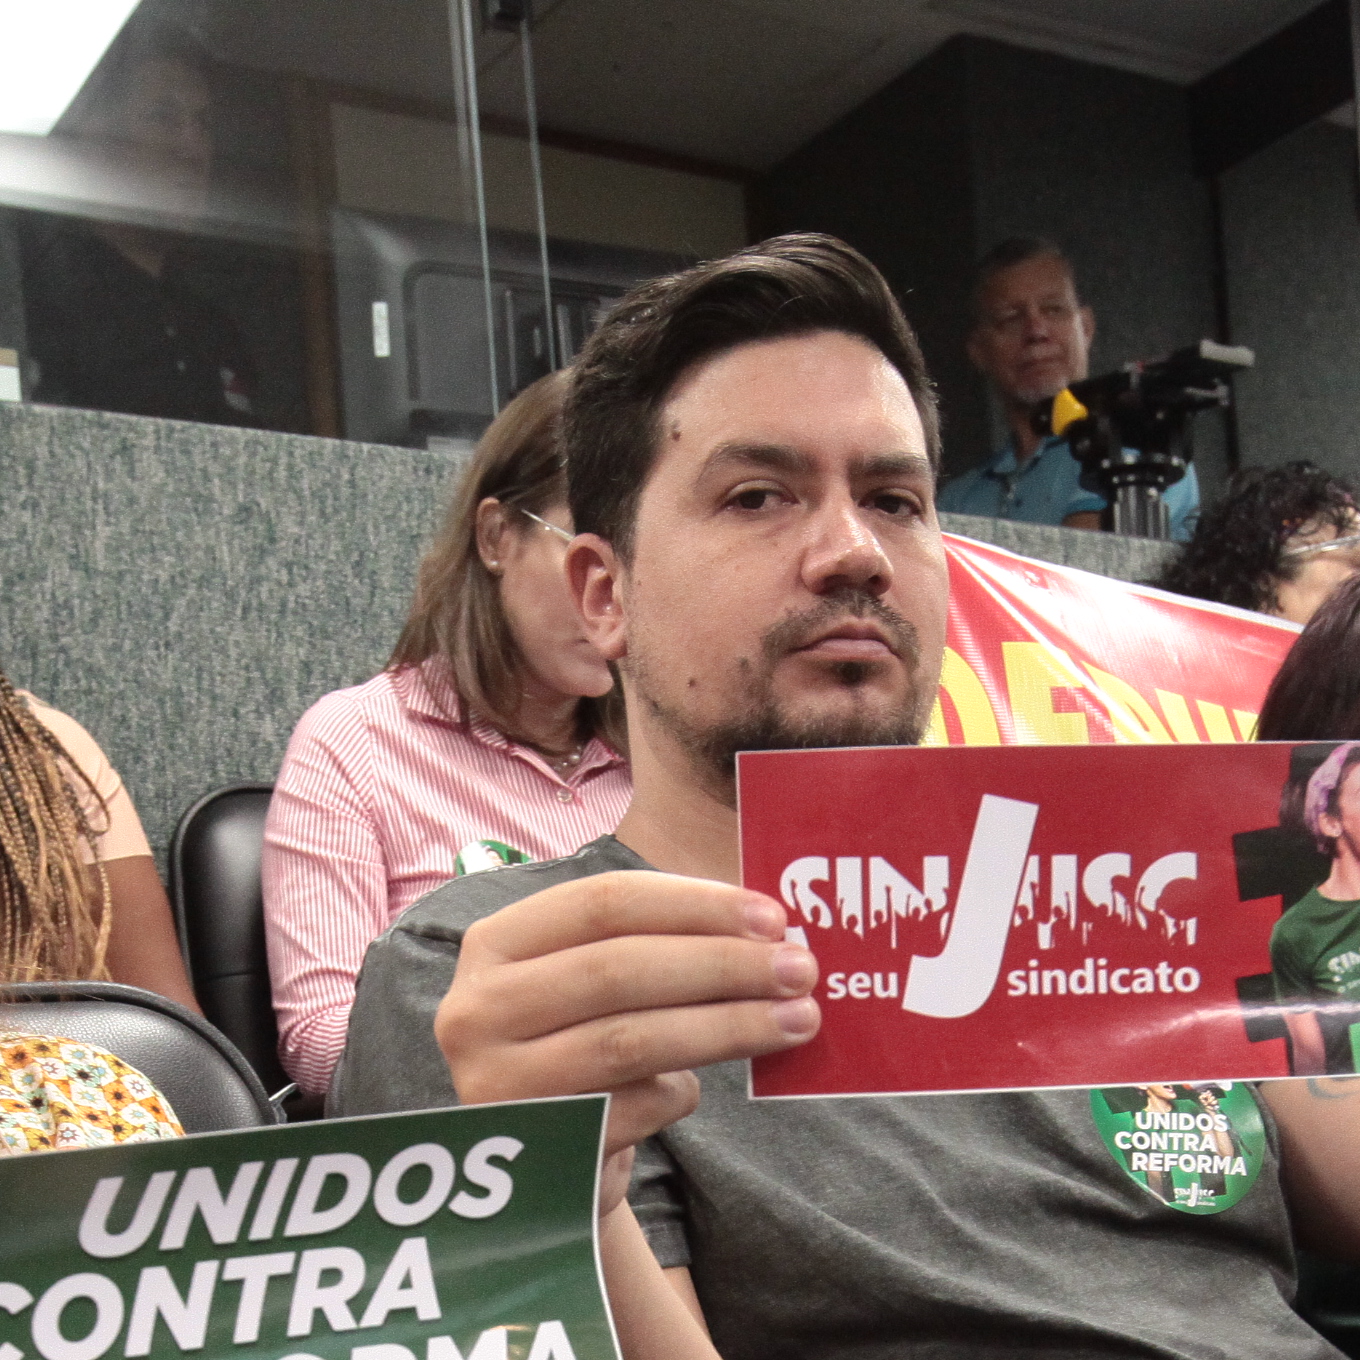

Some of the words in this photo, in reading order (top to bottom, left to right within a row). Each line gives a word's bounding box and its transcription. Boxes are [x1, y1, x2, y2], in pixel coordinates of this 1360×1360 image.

[826, 969, 899, 998] seu
[1007, 958, 1201, 996] sindicato
[1135, 1111, 1228, 1132] UNIDOS
[1114, 1131, 1217, 1152] CONTRA
[1131, 1152, 1248, 1177] REFORMA
[77, 1135, 525, 1259] UNIDOS
